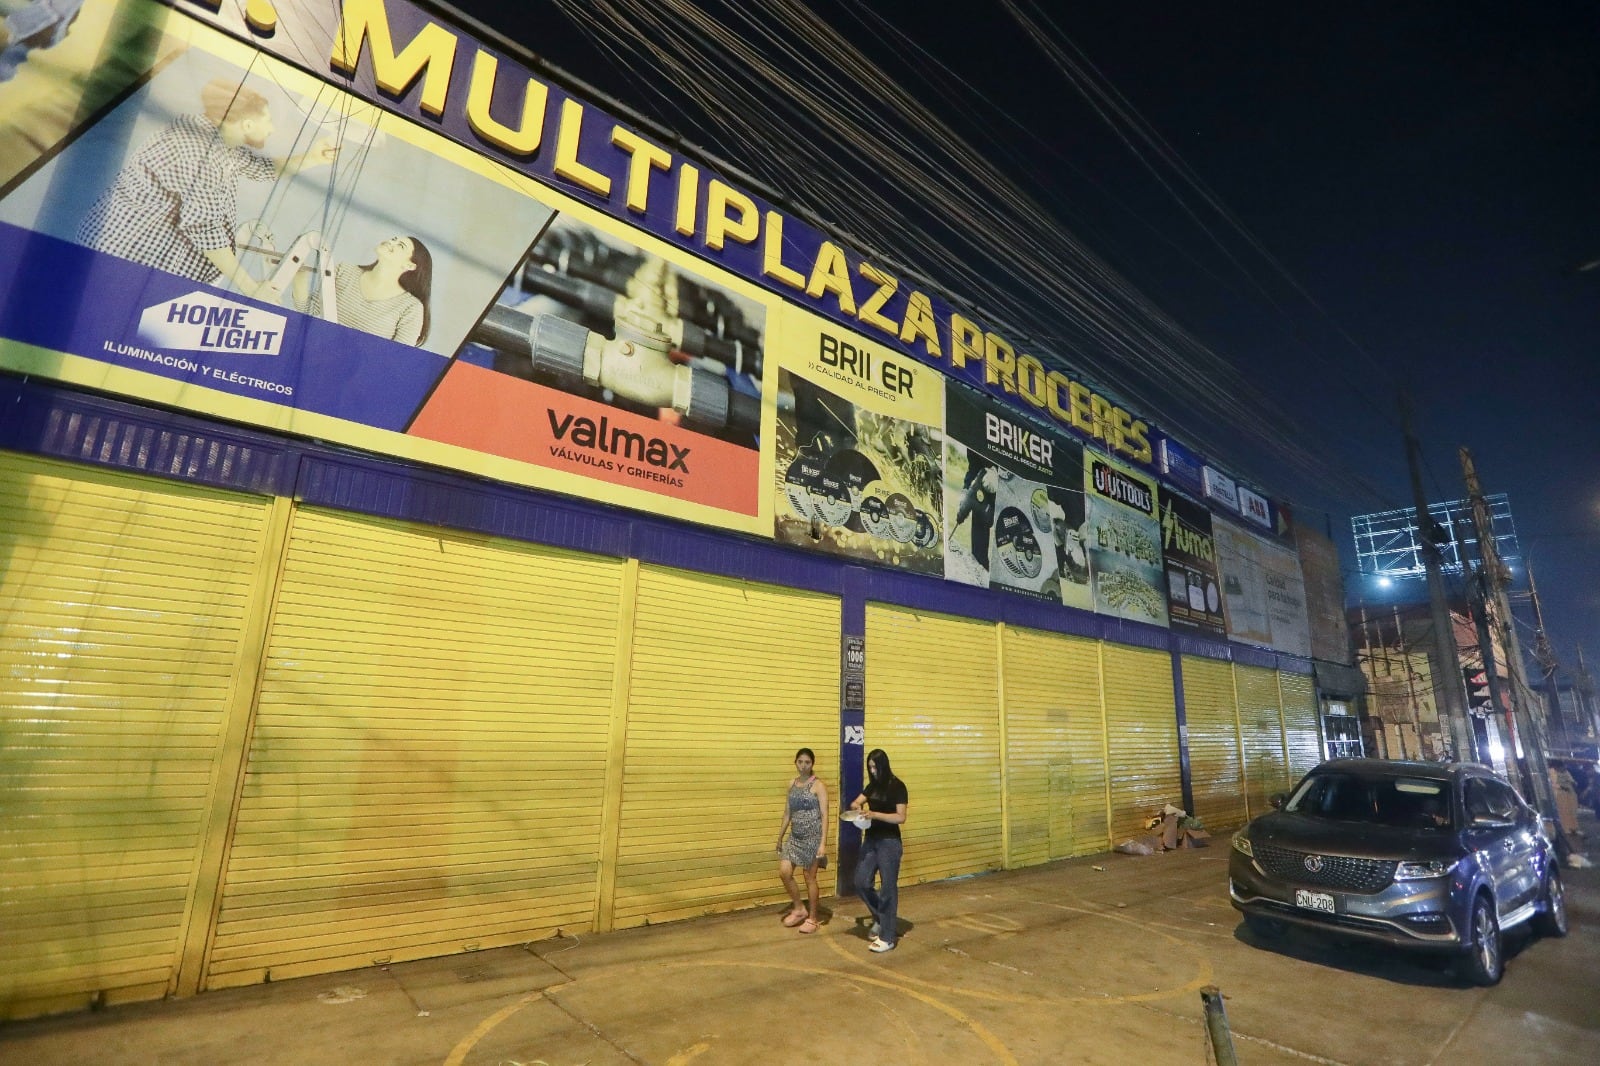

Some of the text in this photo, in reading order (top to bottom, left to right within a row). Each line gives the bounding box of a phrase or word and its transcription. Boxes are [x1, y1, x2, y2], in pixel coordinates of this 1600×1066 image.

[330, 0, 1152, 464] MULTIPLAZA PROCERES
[167, 303, 249, 329] HOME
[200, 327, 278, 351] LIGHT
[104, 340, 294, 396] ILUMINACIÓN Y ELÉCTRICOS
[816, 365, 896, 402] CALIDAD AL PRECIO
[547, 408, 691, 475] valmax
[986, 412, 1053, 468] BRIKER
[550, 446, 684, 488] VÁLVULAS Y GRIFERÍAS
[1296, 893, 1334, 911] CNU-208
